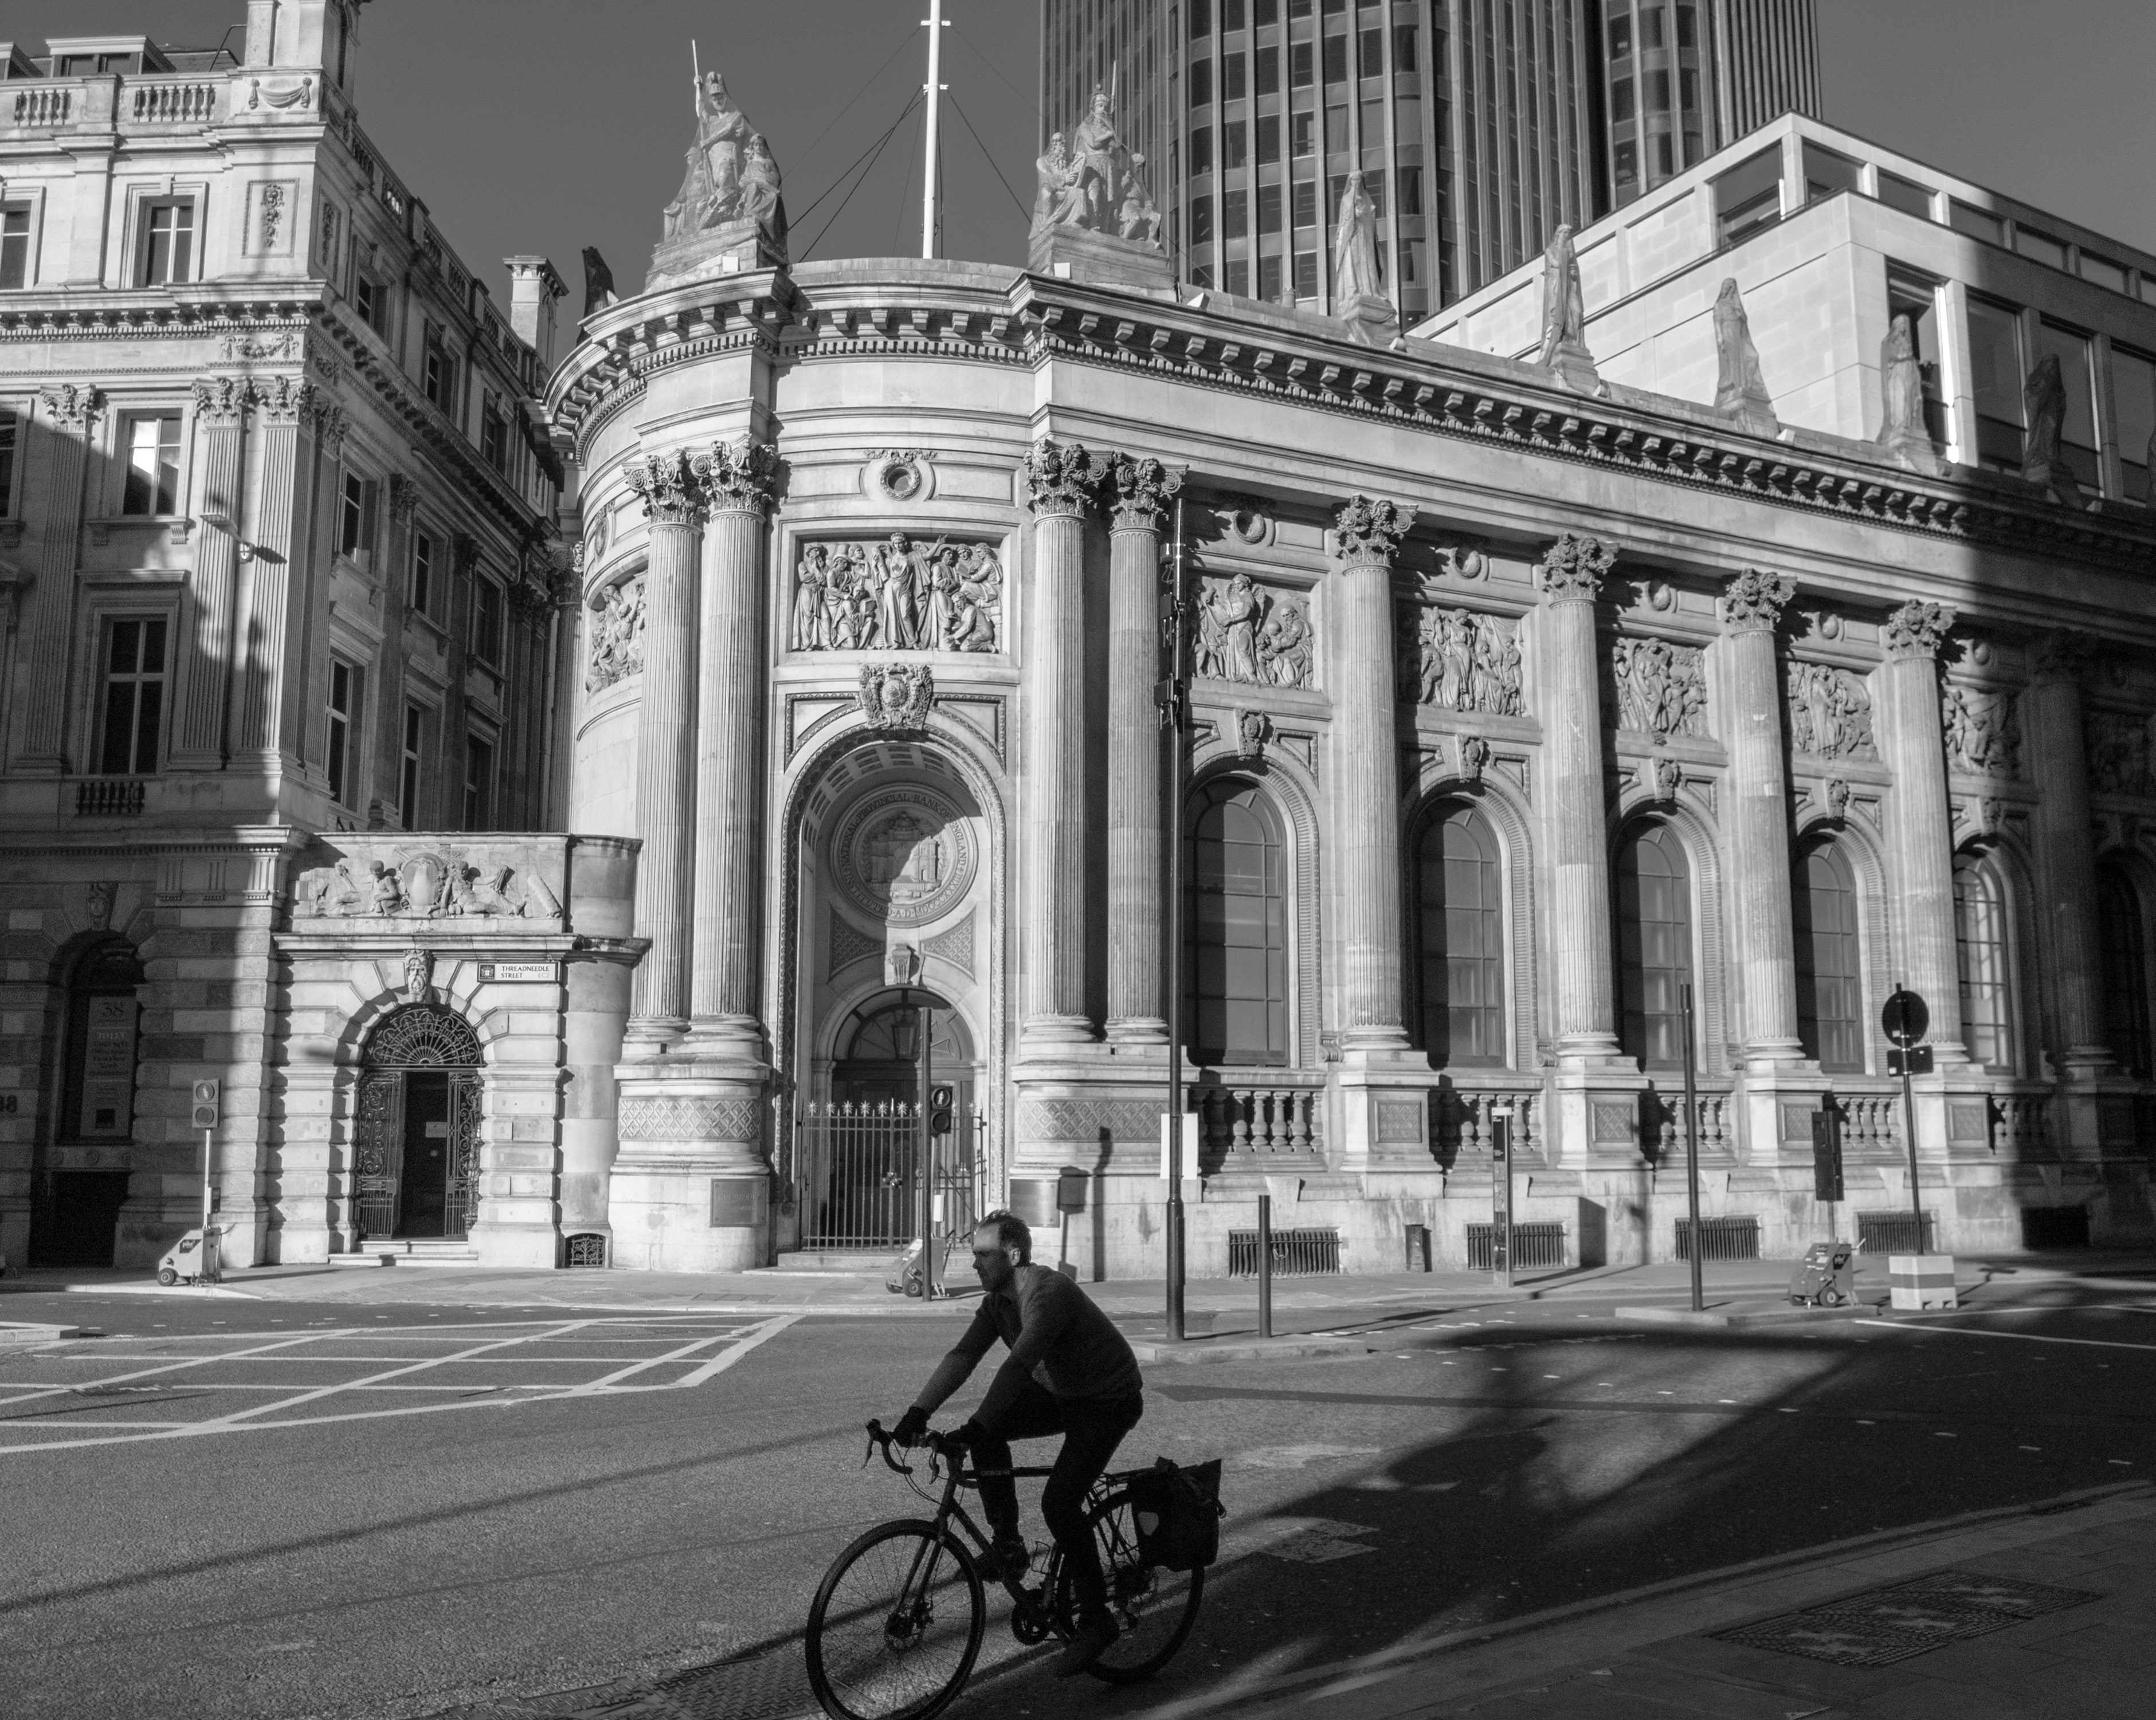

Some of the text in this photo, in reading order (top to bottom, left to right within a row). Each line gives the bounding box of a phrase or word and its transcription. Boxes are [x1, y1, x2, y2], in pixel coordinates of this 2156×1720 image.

[840, 793, 967, 867] NATIONAL PROVINCIAL BANK OF ENGLAND
[844, 872, 892, 916] INSTITUTED
